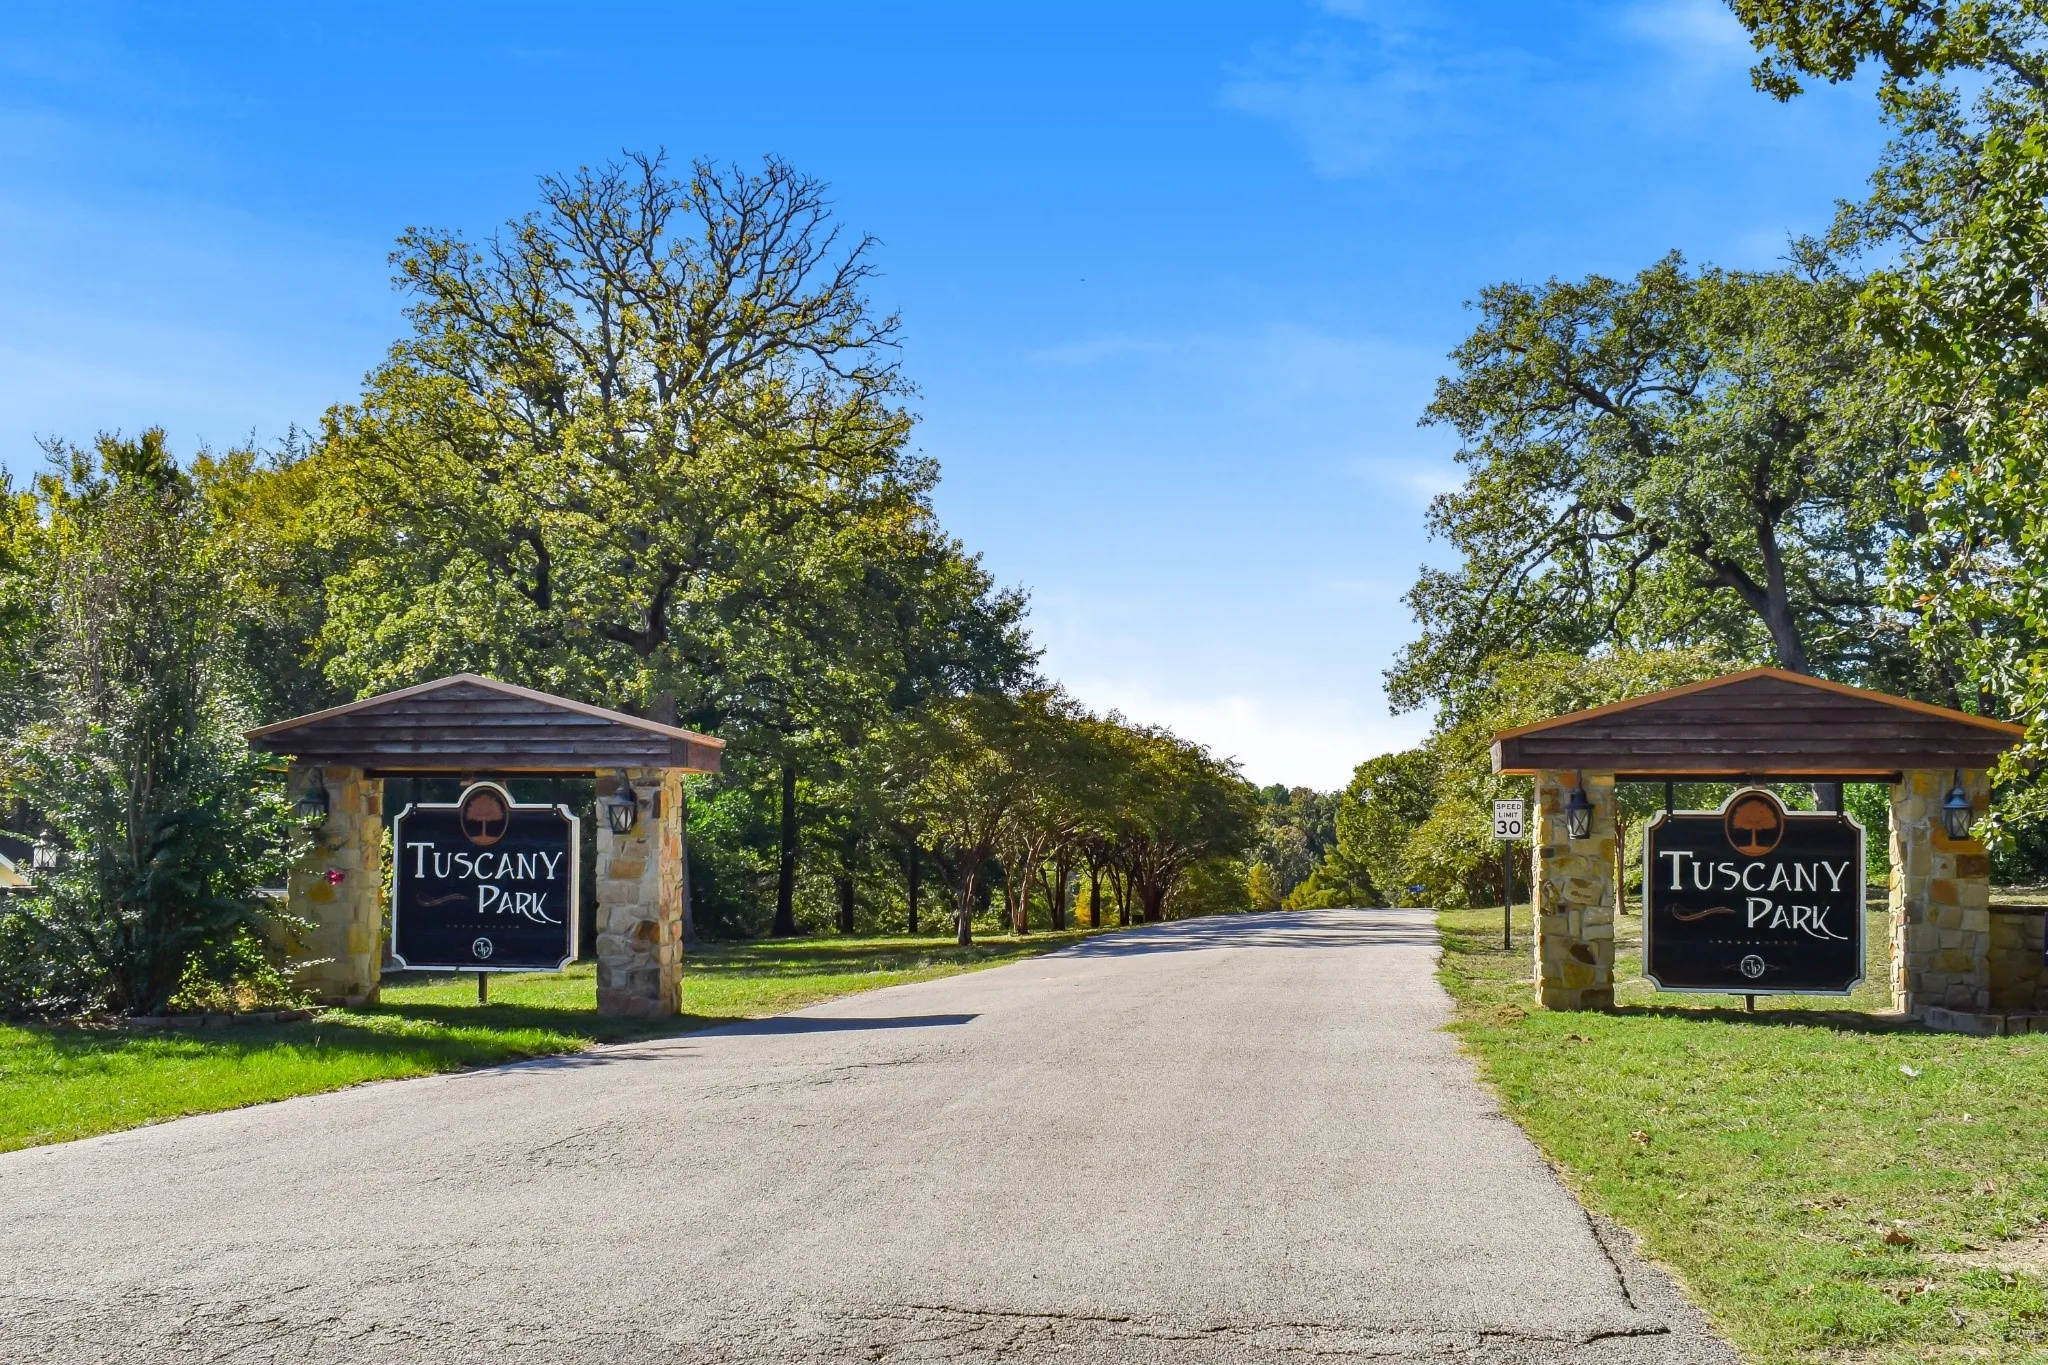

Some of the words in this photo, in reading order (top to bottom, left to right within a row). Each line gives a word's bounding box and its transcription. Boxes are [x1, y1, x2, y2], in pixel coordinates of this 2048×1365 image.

[1496, 820, 1521, 835] 30
[406, 842, 563, 880] TUSCANY
[1659, 850, 1850, 892] TUSCANY
[477, 884, 562, 924] PARK
[1745, 897, 1849, 940] PARK
